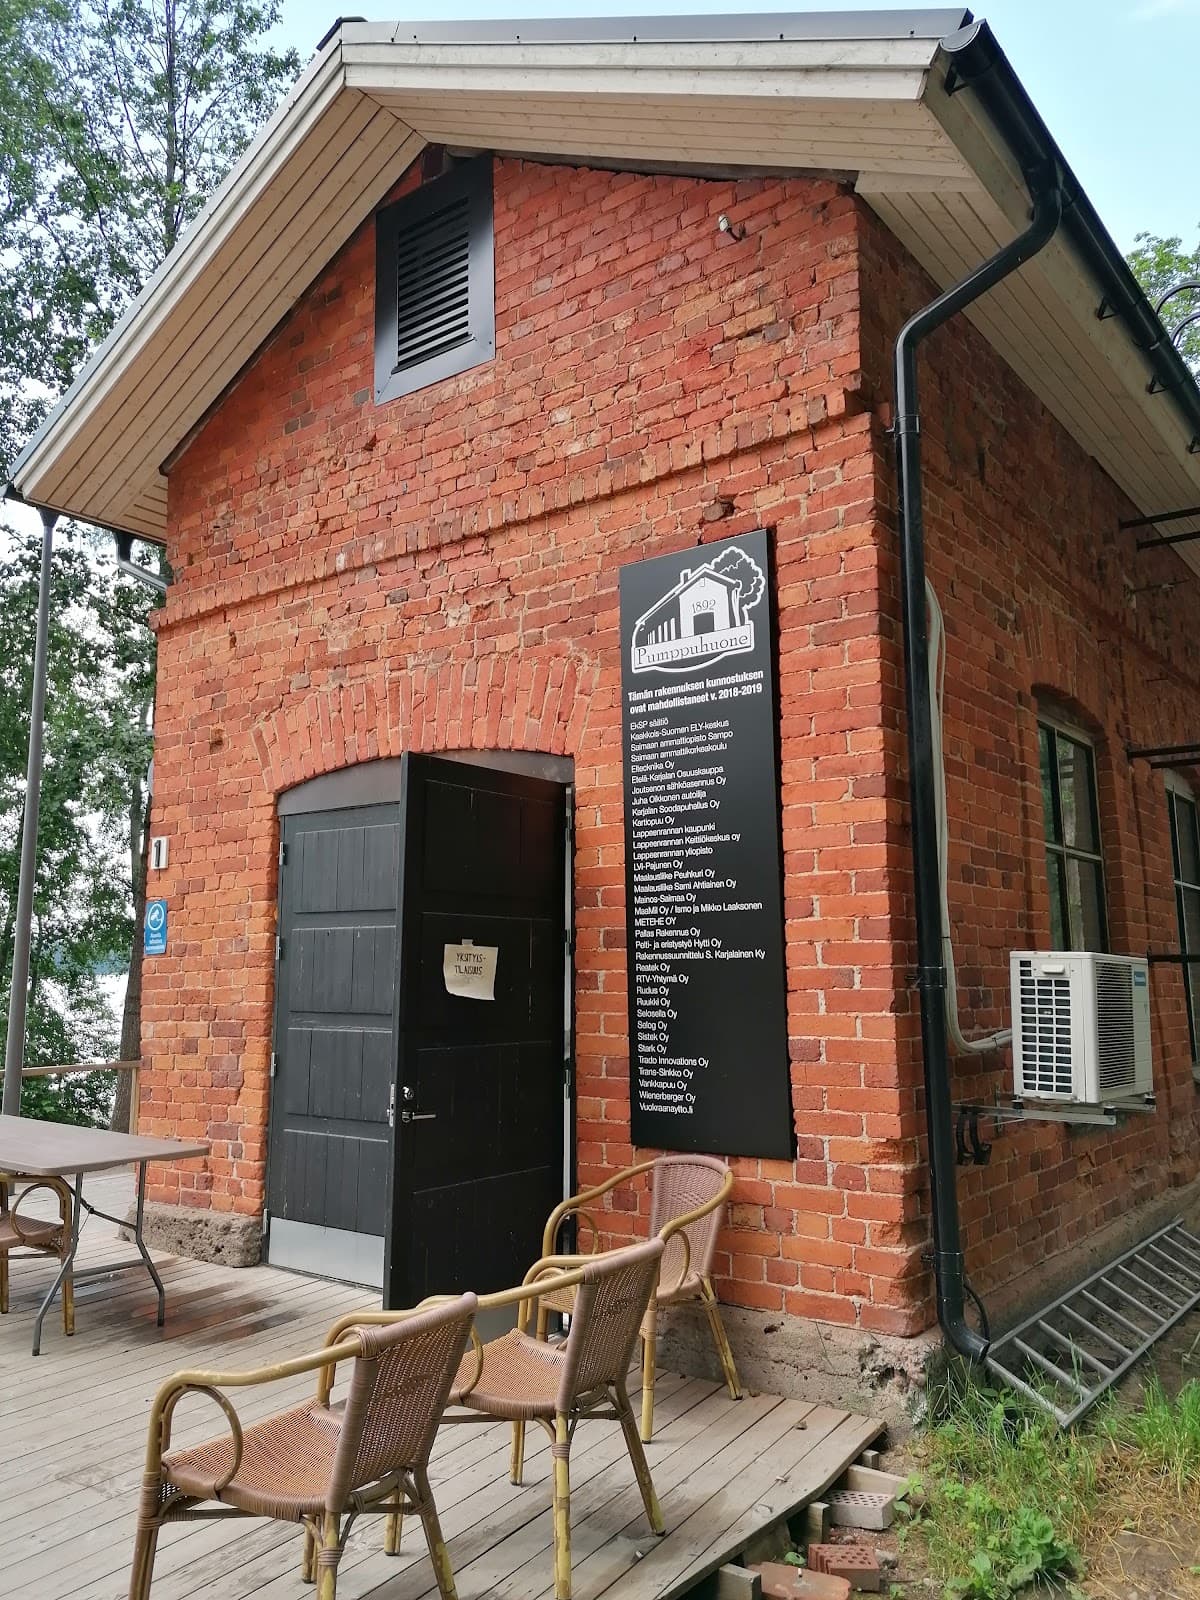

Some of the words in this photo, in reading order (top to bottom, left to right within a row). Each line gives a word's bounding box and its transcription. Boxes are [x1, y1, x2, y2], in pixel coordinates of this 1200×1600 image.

[692, 600, 716, 614] 1892
[636, 635, 748, 665] Pumppuhuone
[628, 690, 654, 702] Tämän
[654, 681, 705, 697] rakennuksen
[706, 670, 764, 688] kunnostuksen
[630, 703, 647, 715] ovat
[647, 692, 709, 711] mahdollistaneet
[710, 691, 718, 701] v.
[718, 683, 763, 700] 2018-2019
[630, 726, 690, 742] Kaakkois-Suomen
[690, 719, 730, 732] ELY-keskus
[631, 742, 659, 752] Saimaan
[659, 734, 707, 748] ammattiopisto
[708, 731, 734, 741] Sampo
[631, 753, 659, 763] Saimaan
[660, 742, 728, 758] ammattikorkeakoulu
[664, 760, 675, 770] Oy
[631, 772, 676, 784] Etelä-Karjalan
[676, 766, 724, 778] Osuuskauppa
[631, 785, 666, 795] Joutsenon
[666, 778, 715, 791] sähköasennus
[715, 776, 727, 786] Oy
[631, 796, 649, 806] Juha
[681, 790, 707, 800] autoilija
[632, 807, 658, 817] Karjalan
[659, 801, 709, 814] Soodapuhallus
[709, 800, 720, 809] Oy
[664, 816, 675, 825] Oy
[632, 826, 684, 839] Lappeenrannan
[684, 823, 716, 834] kaupunki
[632, 837, 684, 850] Lappeenrannan
[684, 834, 731, 845] Keittiökeskus
[731, 833, 741, 842] oy
[154, 839, 162, 868] 1
[633, 848, 685, 861] Lappeenrannan
[685, 846, 714, 857] yliopisto
[633, 861, 672, 871] LVI-Pajunen
[672, 859, 684, 869] Oy
[633, 871, 673, 883] Maalausliike
[673, 869, 704, 879] Peuhkuri
[704, 868, 716, 878] Oy
[633, 883, 673, 893] Maalausliike
[674, 881, 692, 891] Sami
[692, 880, 725, 890] Ahtiainen
[725, 879, 737, 889] Oy
[634, 893, 686, 905] Mainos-Saimaa
[685, 892, 697, 902] Oy
[658, 905, 670, 916] Oy
[674, 904, 693, 914] Ismo
[692, 904, 700, 914] ja
[700, 902, 722, 912] Mikko
[722, 901, 763, 911] Laaksonen
[634, 916, 665, 927] METEHE
[664, 915, 677, 926] OY
[634, 928, 655, 938] Pallas
[655, 926, 690, 937] Rakennus
[689, 925, 701, 937] Oy
[635, 939, 653, 949] Pelti-
[653, 939, 660, 950] ja
[660, 938, 693, 950] eristystyö
[693, 938, 711, 950] Hytti
[710, 937, 722, 948] Oy
[635, 950, 704, 961] Rakennussuunnittelu
[704, 949, 714, 960] S.
[714, 948, 754, 961] Karjalainen
[754, 948, 766, 960] Ky
[659, 962, 671, 973] Oy
[635, 974, 678, 985] RTV-Yhtymä
[678, 973, 690, 985] Oy
[636, 986, 659, 995] Rudus
[658, 985, 670, 996] Oy
[636, 997, 660, 1006] Ruukki
[659, 996, 671, 1008] Oy
[666, 1009, 678, 1020] Oy
[657, 1020, 668, 1031] Oy
[637, 1032, 659, 1041] Sistek
[658, 1032, 670, 1043] Oy
[637, 1043, 656, 1053] Stark
[656, 1044, 667, 1055] Oy
[638, 1055, 658, 1064] Trado
[658, 1056, 698, 1067] Innovations
[697, 1057, 710, 1068] Oy
[638, 1066, 682, 1077] Trans-Sinkko
[682, 1068, 694, 1080] Oy
[638, 1078, 676, 1090] Vankkapuu
[676, 1080, 688, 1091] Oy
[638, 1090, 685, 1103] Wienerberger
[684, 1092, 696, 1104] Oy
